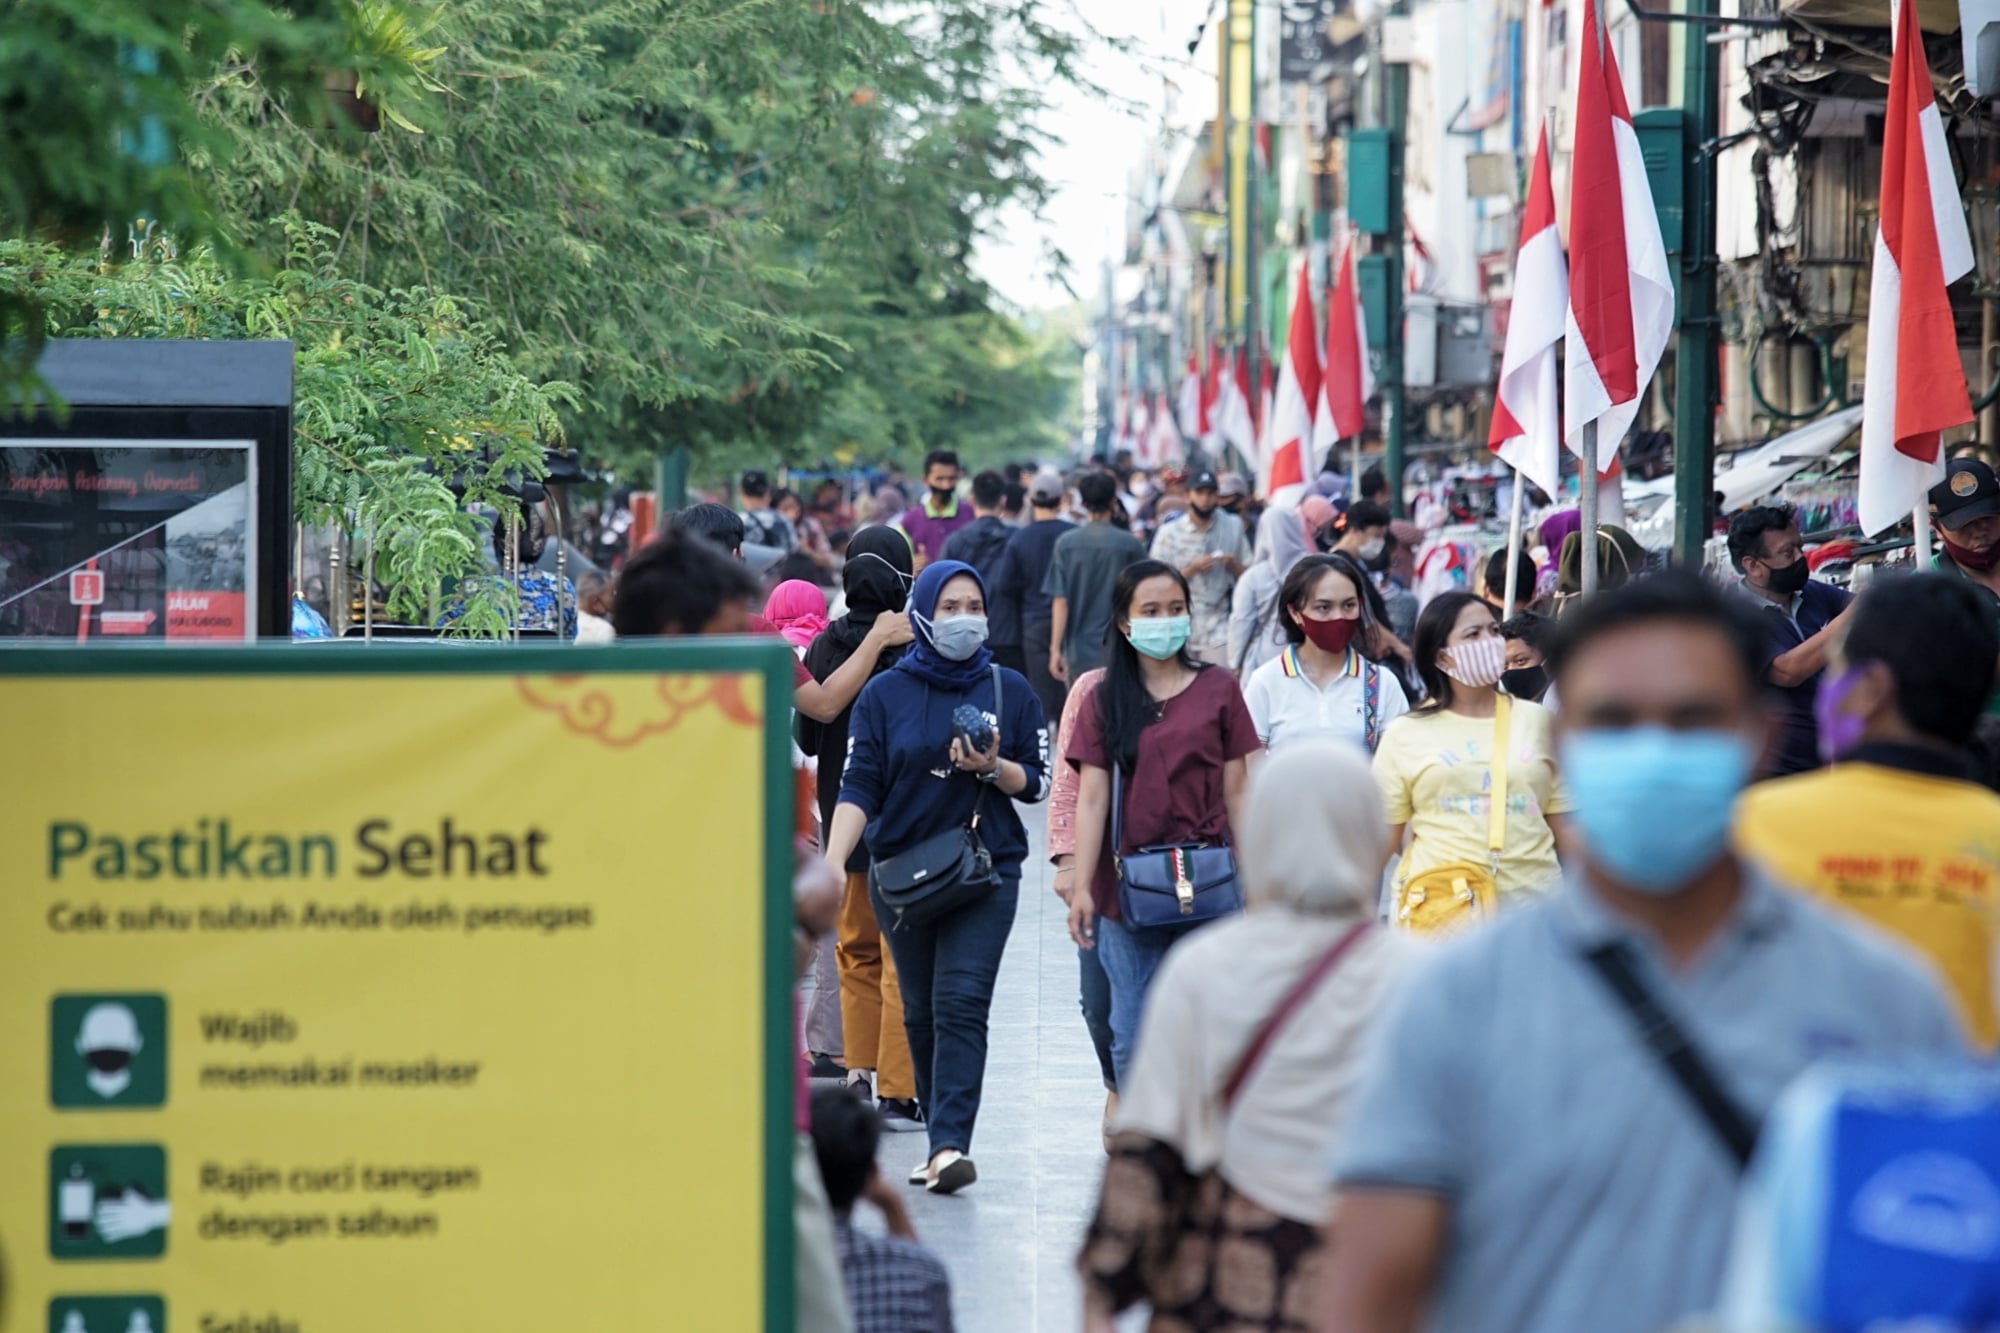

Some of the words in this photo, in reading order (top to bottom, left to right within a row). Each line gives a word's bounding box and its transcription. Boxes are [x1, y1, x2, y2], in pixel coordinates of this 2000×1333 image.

[167, 598, 209, 612] JALAN
[47, 818, 337, 881] Pastikan
[355, 817, 549, 879] Sehat
[48, 903, 108, 932] Cek
[117, 904, 192, 930] suhu
[198, 904, 292, 930] tubuh
[301, 903, 383, 929] Anda
[391, 903, 458, 928] oleh
[465, 905, 592, 934] petugas
[201, 1013, 296, 1045] Wajib
[200, 1060, 352, 1087] memakai
[360, 1060, 479, 1086] masker
[200, 1163, 282, 1198] Rajin
[288, 1166, 355, 1191] cuci
[361, 1167, 479, 1196] tangan
[200, 1211, 330, 1244] dengan
[337, 1209, 437, 1236] sabun
